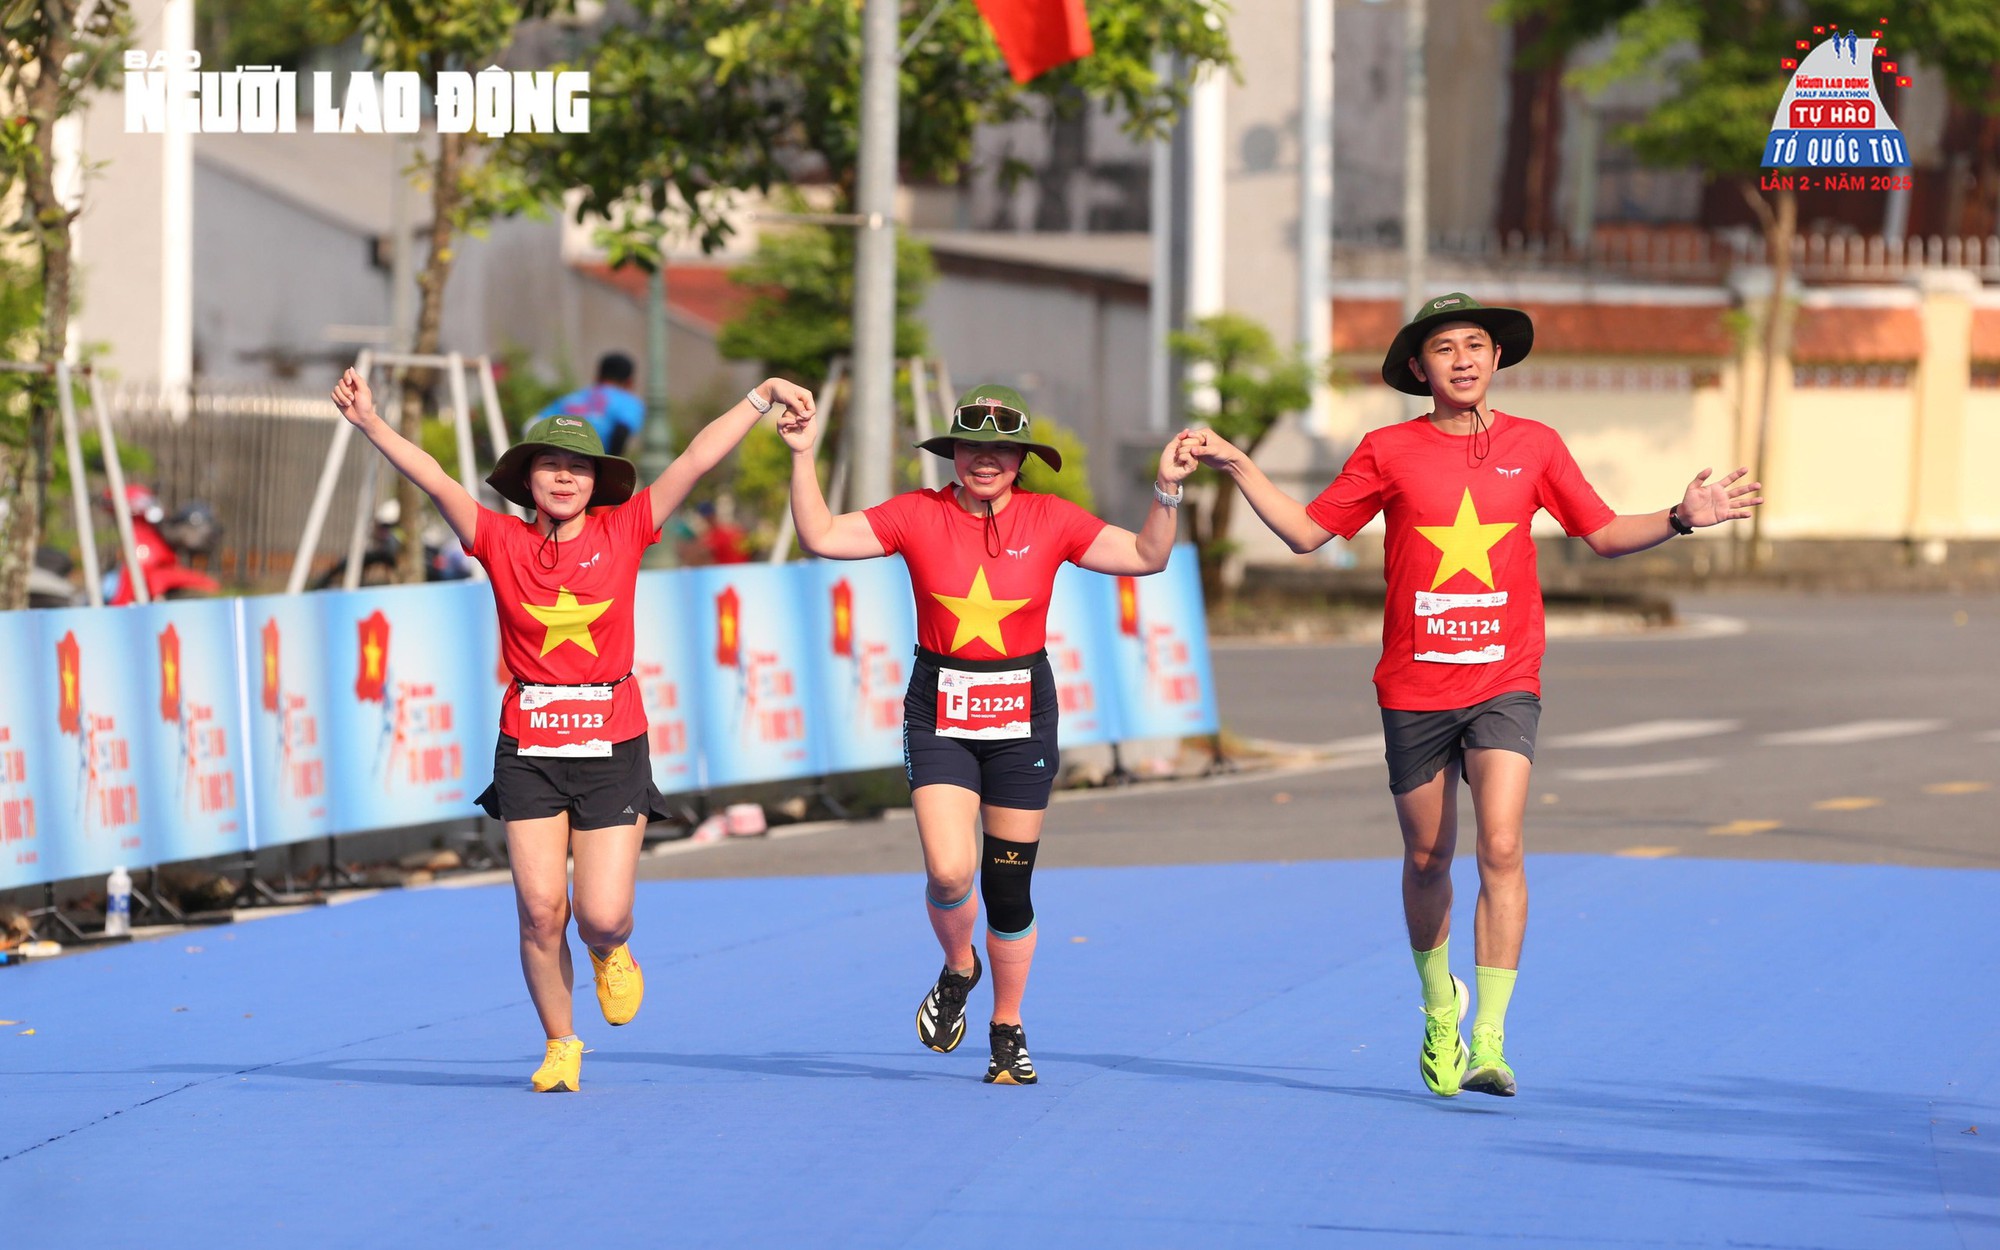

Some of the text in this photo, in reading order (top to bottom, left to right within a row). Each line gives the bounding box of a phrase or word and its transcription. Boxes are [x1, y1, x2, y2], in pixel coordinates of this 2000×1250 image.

[1427, 617, 1500, 635] M21124
[970, 696, 1025, 712] 21224
[530, 711, 604, 729] M21123
[994, 857, 1029, 866] VANTELIN
